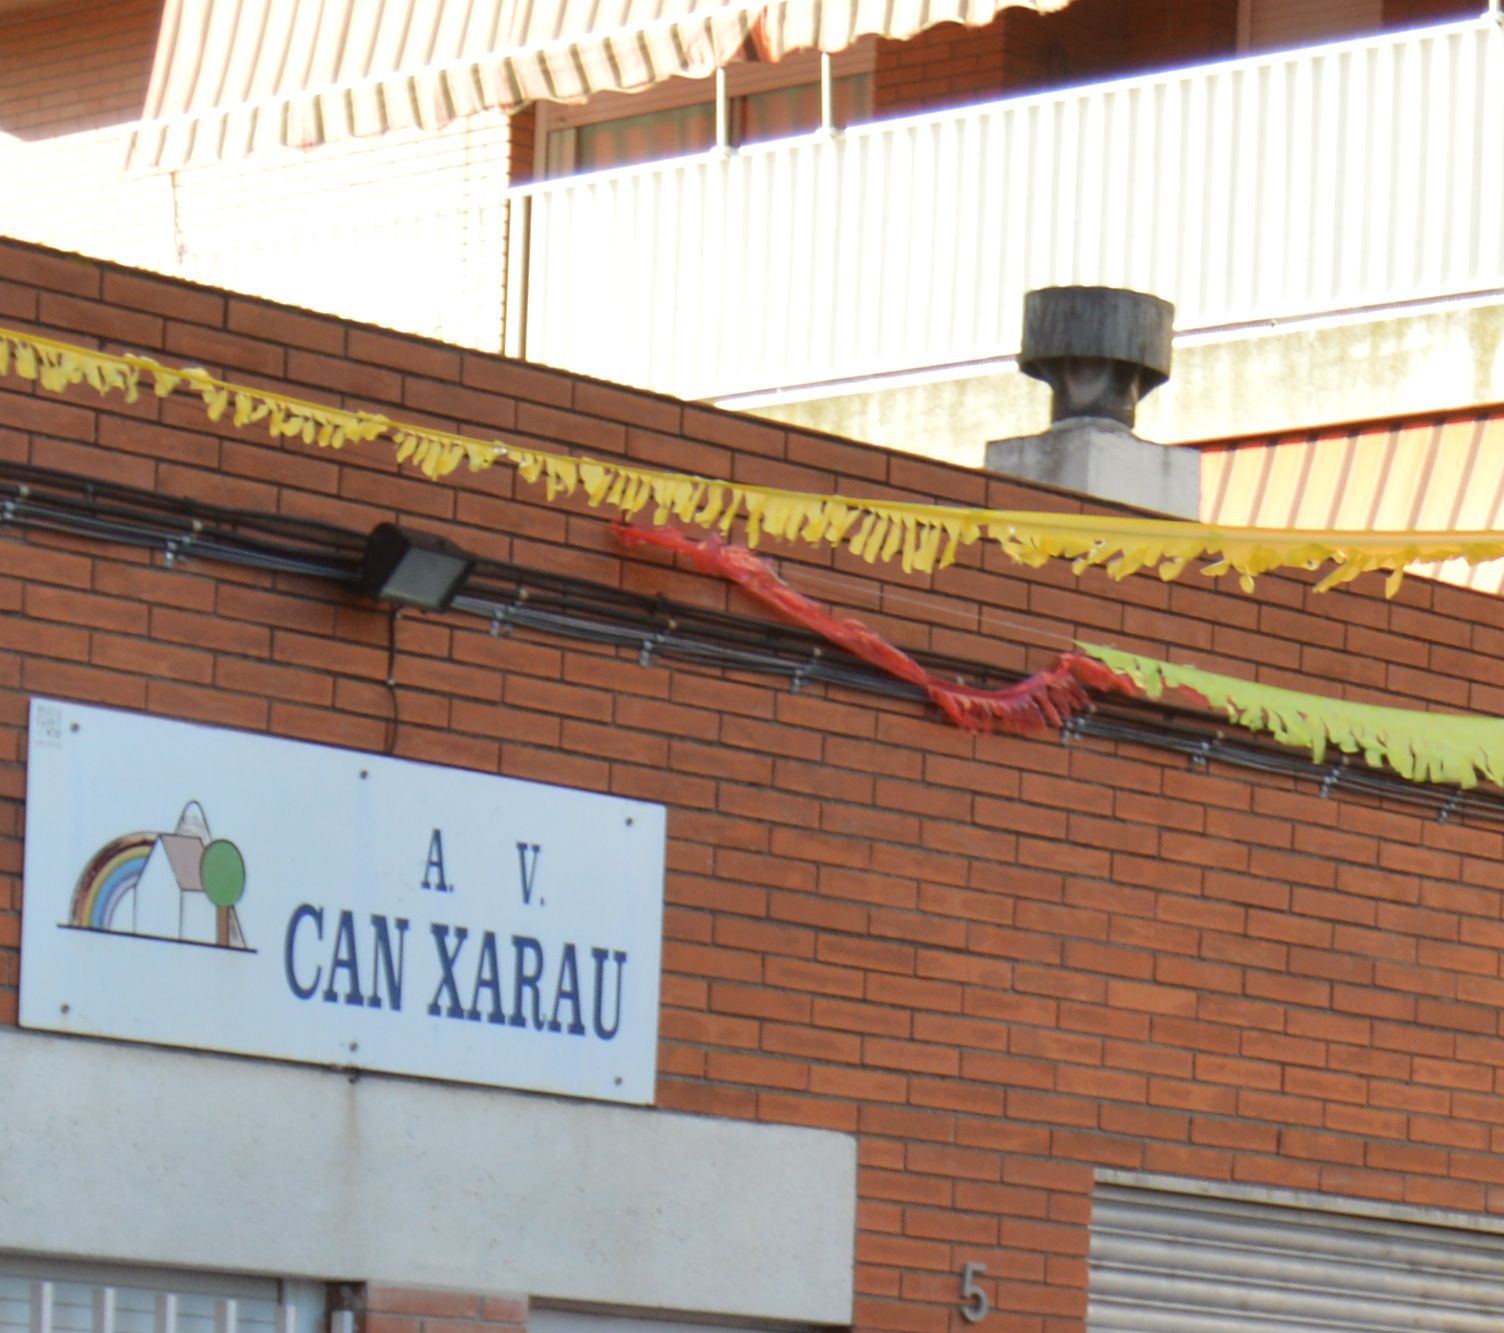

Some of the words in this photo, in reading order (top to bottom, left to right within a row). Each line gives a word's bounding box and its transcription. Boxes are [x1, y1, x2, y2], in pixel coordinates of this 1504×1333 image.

[421, 828, 455, 893] A.
[516, 842, 545, 906] V.
[284, 902, 410, 1011] CAN
[427, 921, 628, 1041] XARAU
